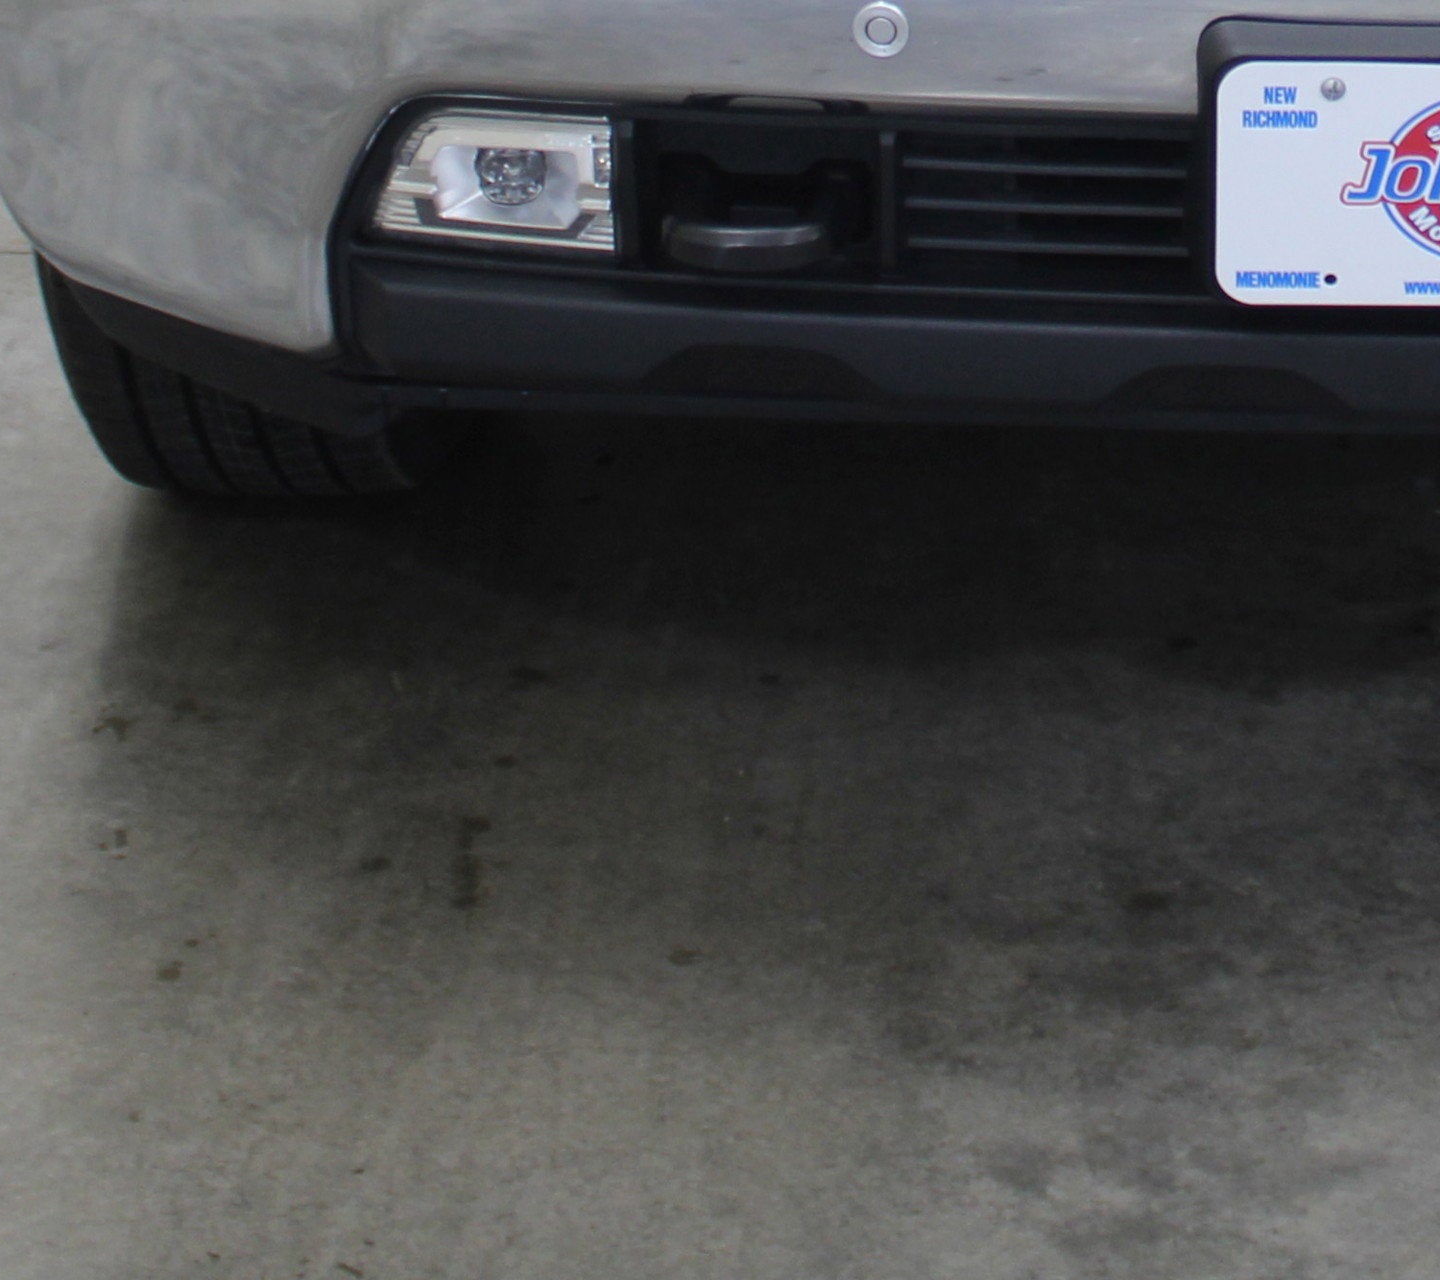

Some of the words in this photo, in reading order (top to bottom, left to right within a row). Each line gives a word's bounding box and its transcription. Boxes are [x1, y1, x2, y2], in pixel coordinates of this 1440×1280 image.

[1263, 87, 1297, 105] NEW
[1242, 110, 1318, 129] RICHMOND
[1235, 271, 1321, 289] MENOMONIE
